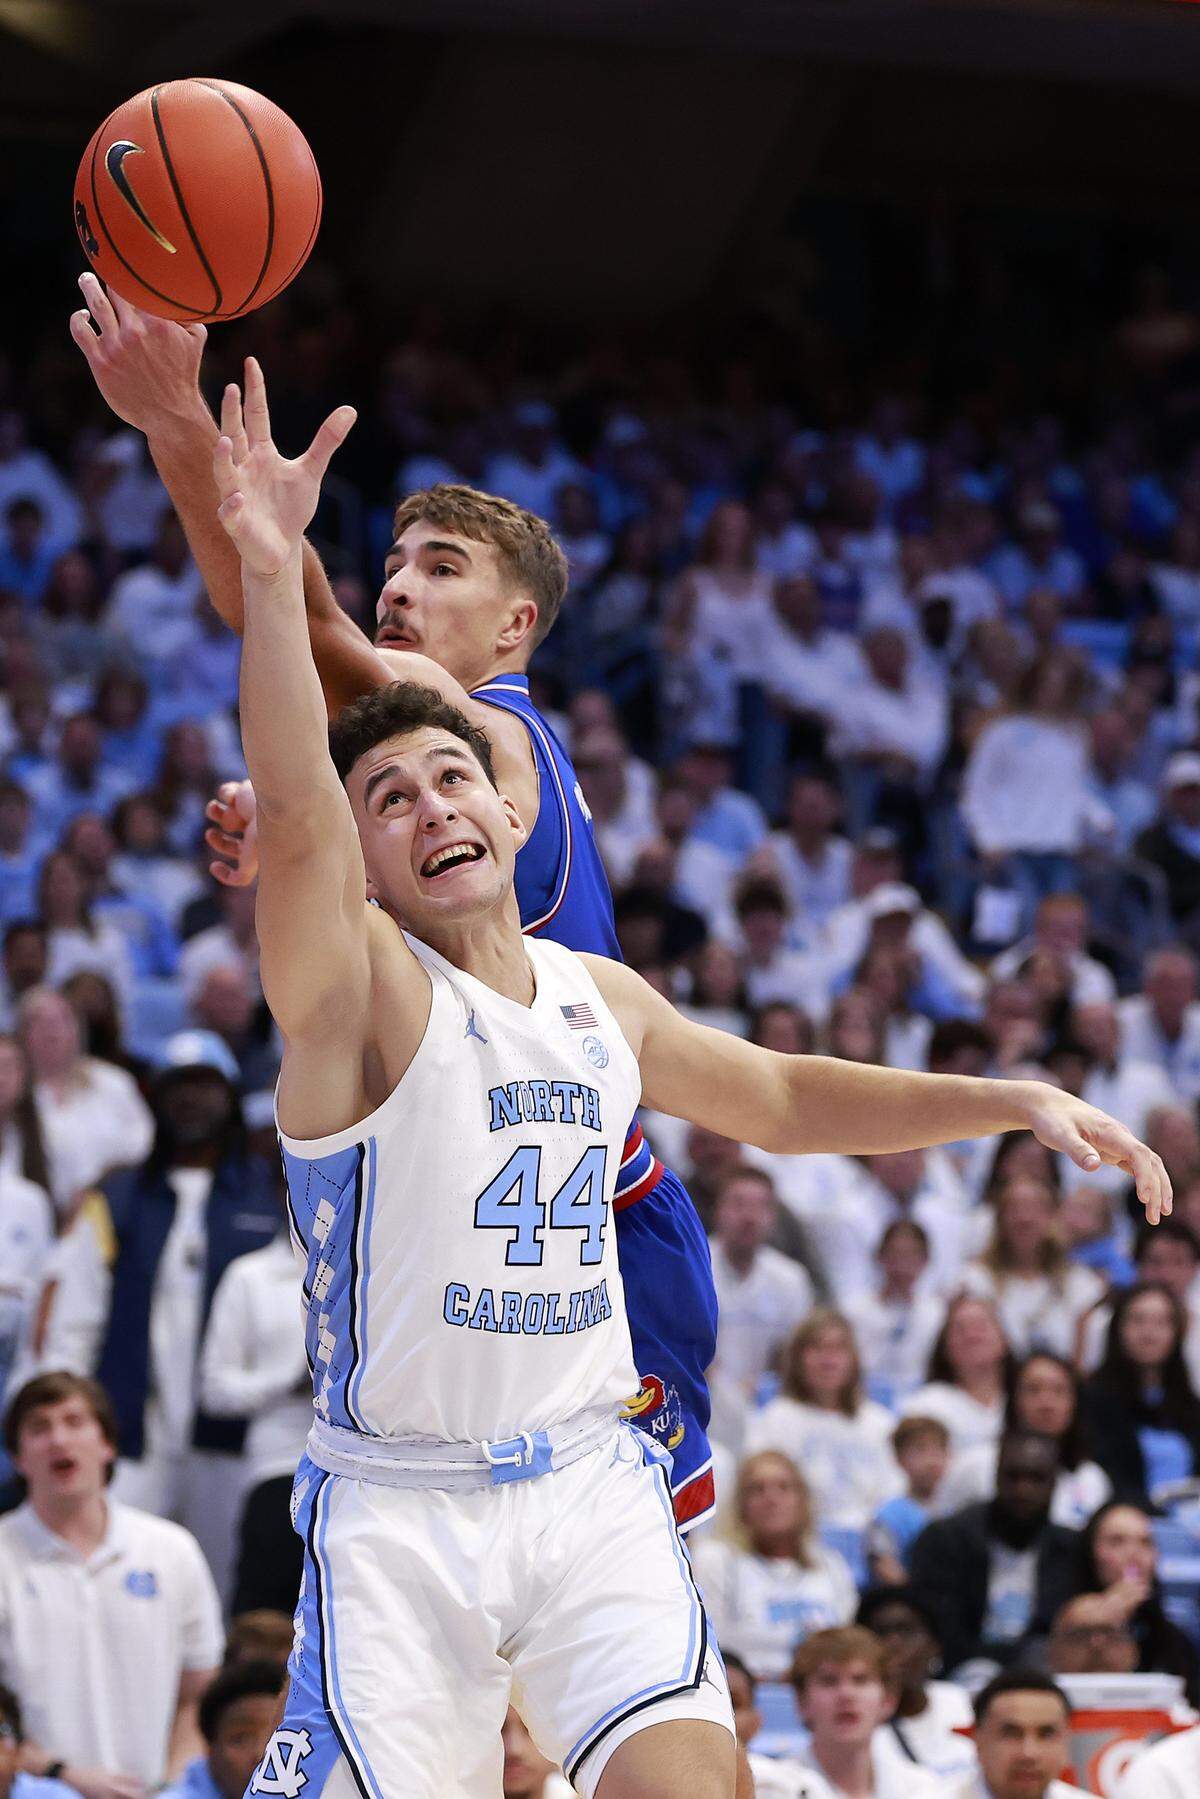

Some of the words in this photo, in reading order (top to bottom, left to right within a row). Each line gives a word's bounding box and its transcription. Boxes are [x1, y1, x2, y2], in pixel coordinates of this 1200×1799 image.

[488, 1080, 602, 1132] NORTH
[473, 1145, 608, 1266] 44
[443, 1278, 612, 1335] CAROLINA
[651, 1411, 670, 1435] KU
